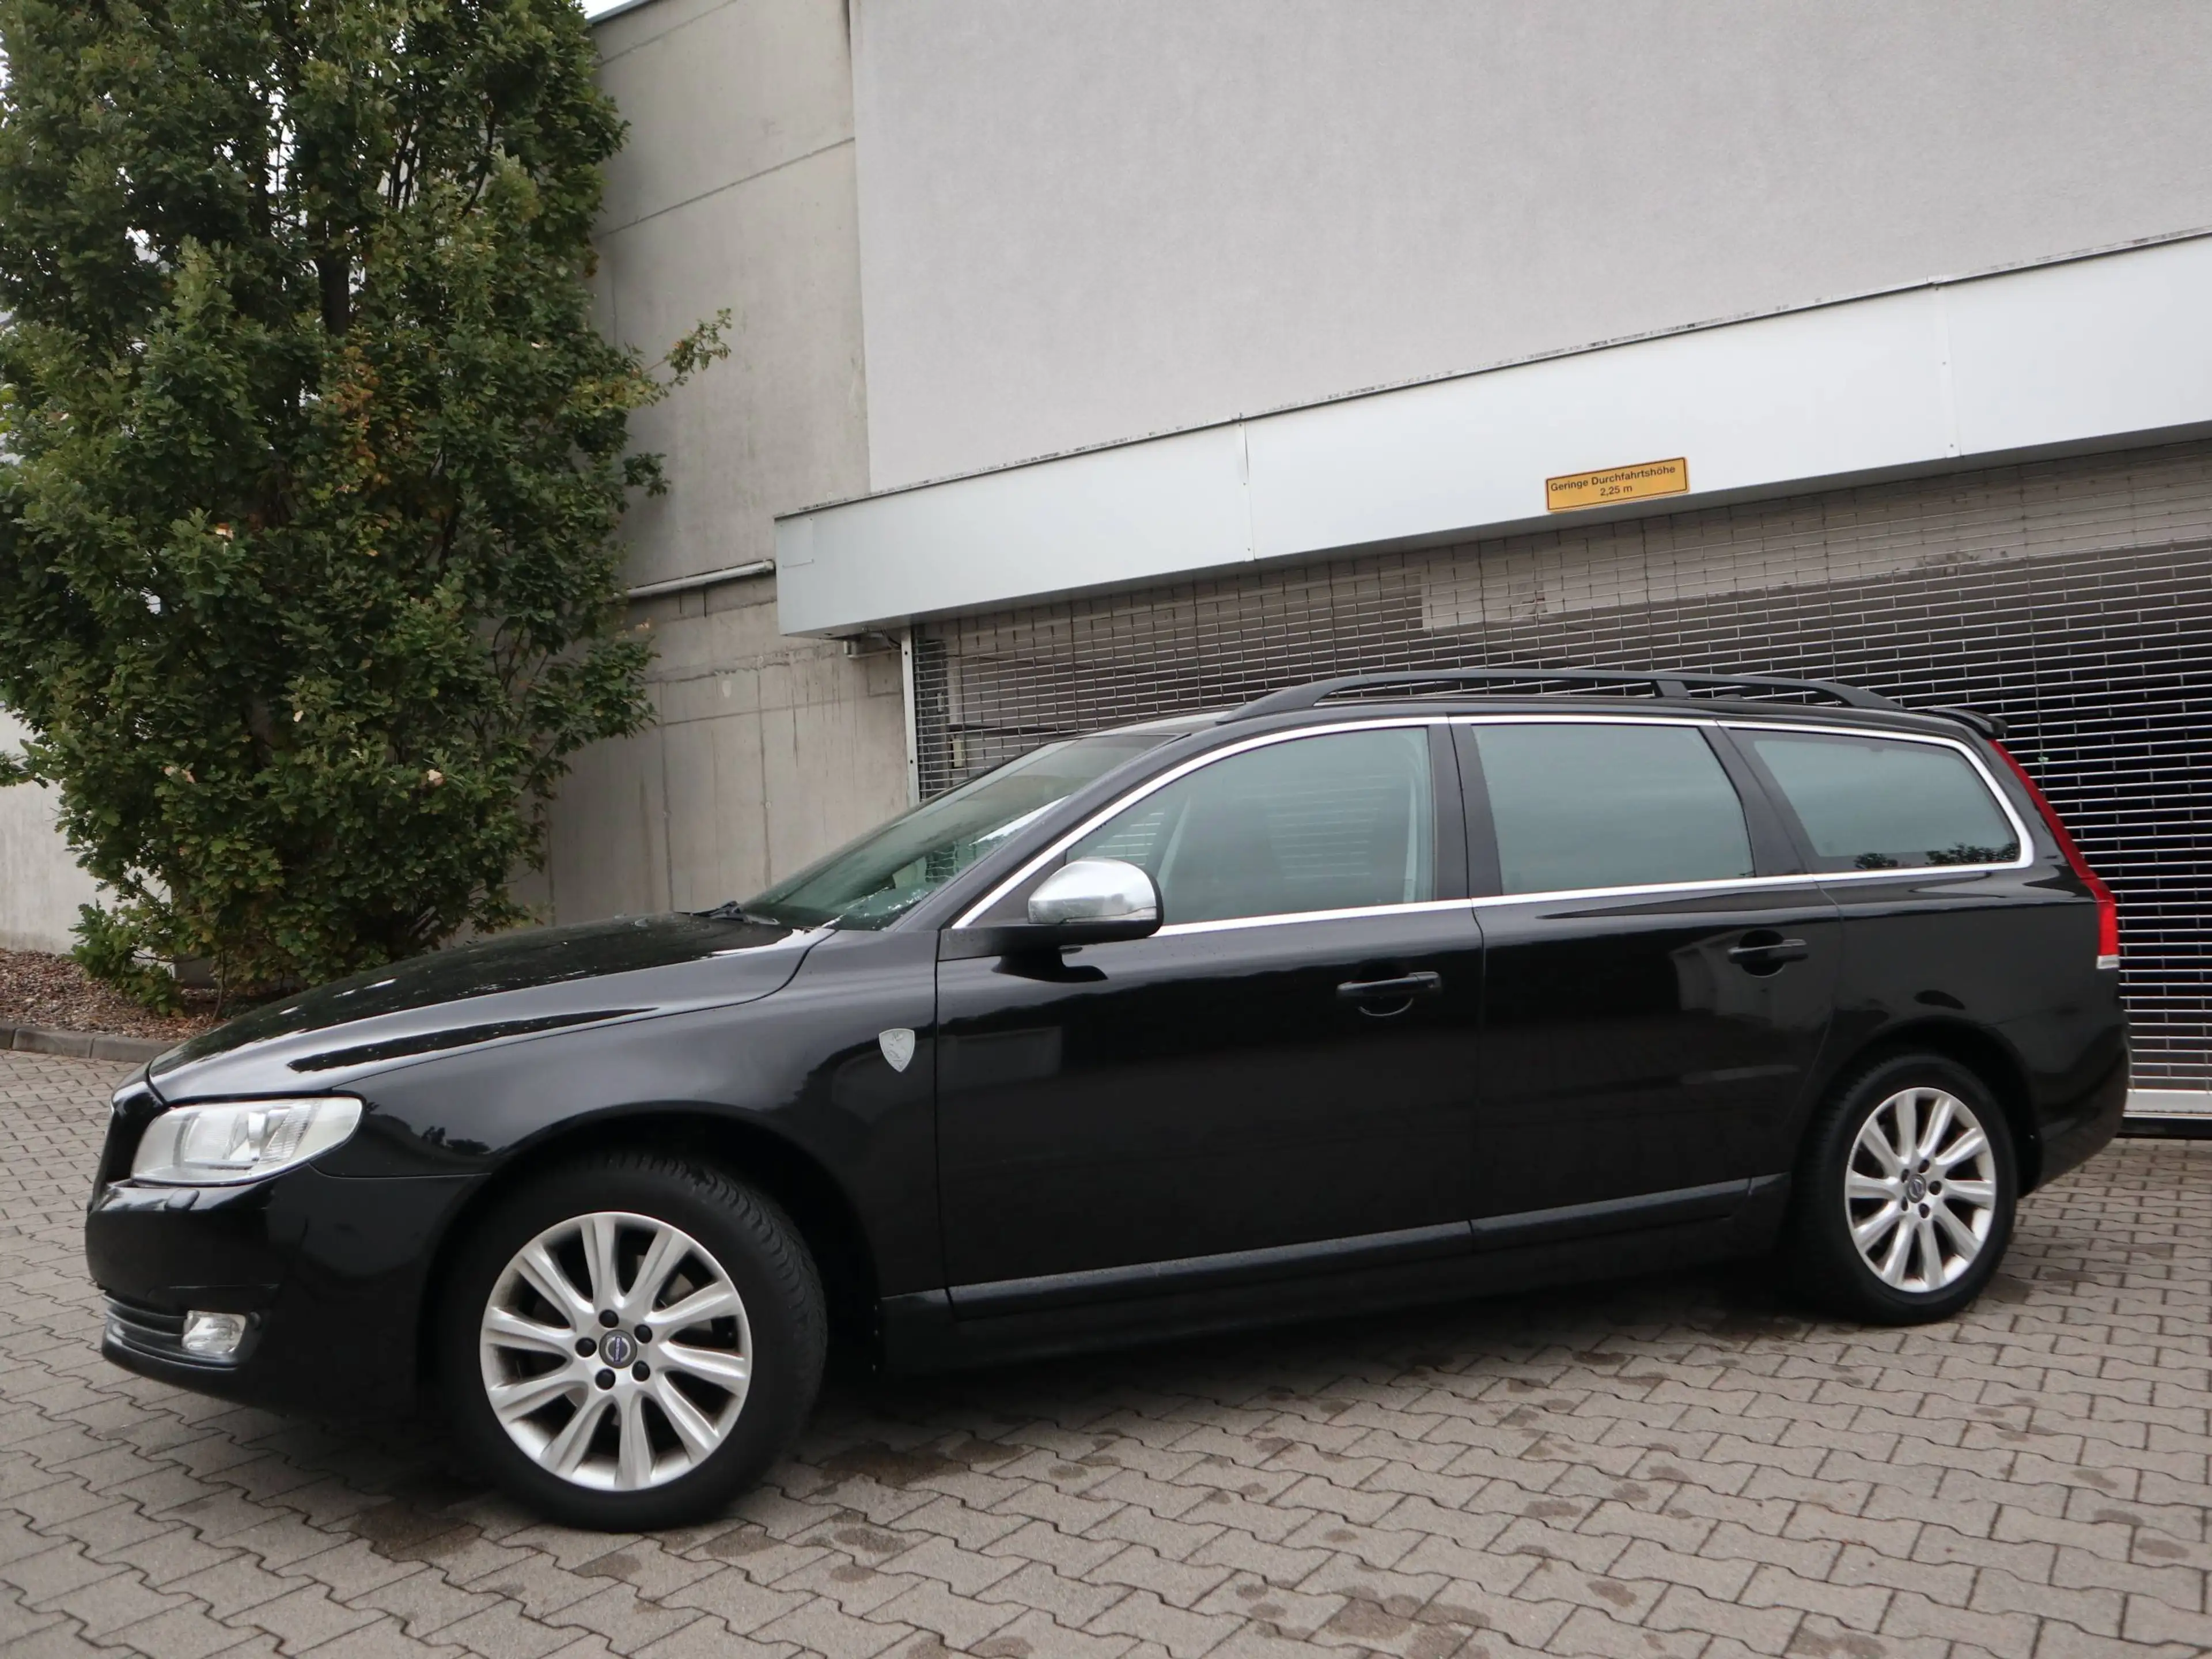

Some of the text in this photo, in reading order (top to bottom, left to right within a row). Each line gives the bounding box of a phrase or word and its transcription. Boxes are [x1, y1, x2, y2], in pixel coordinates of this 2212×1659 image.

[1551, 465, 1675, 491] Geringe Durchfahrtshöhe
[1600, 486, 1620, 497] 2,25
